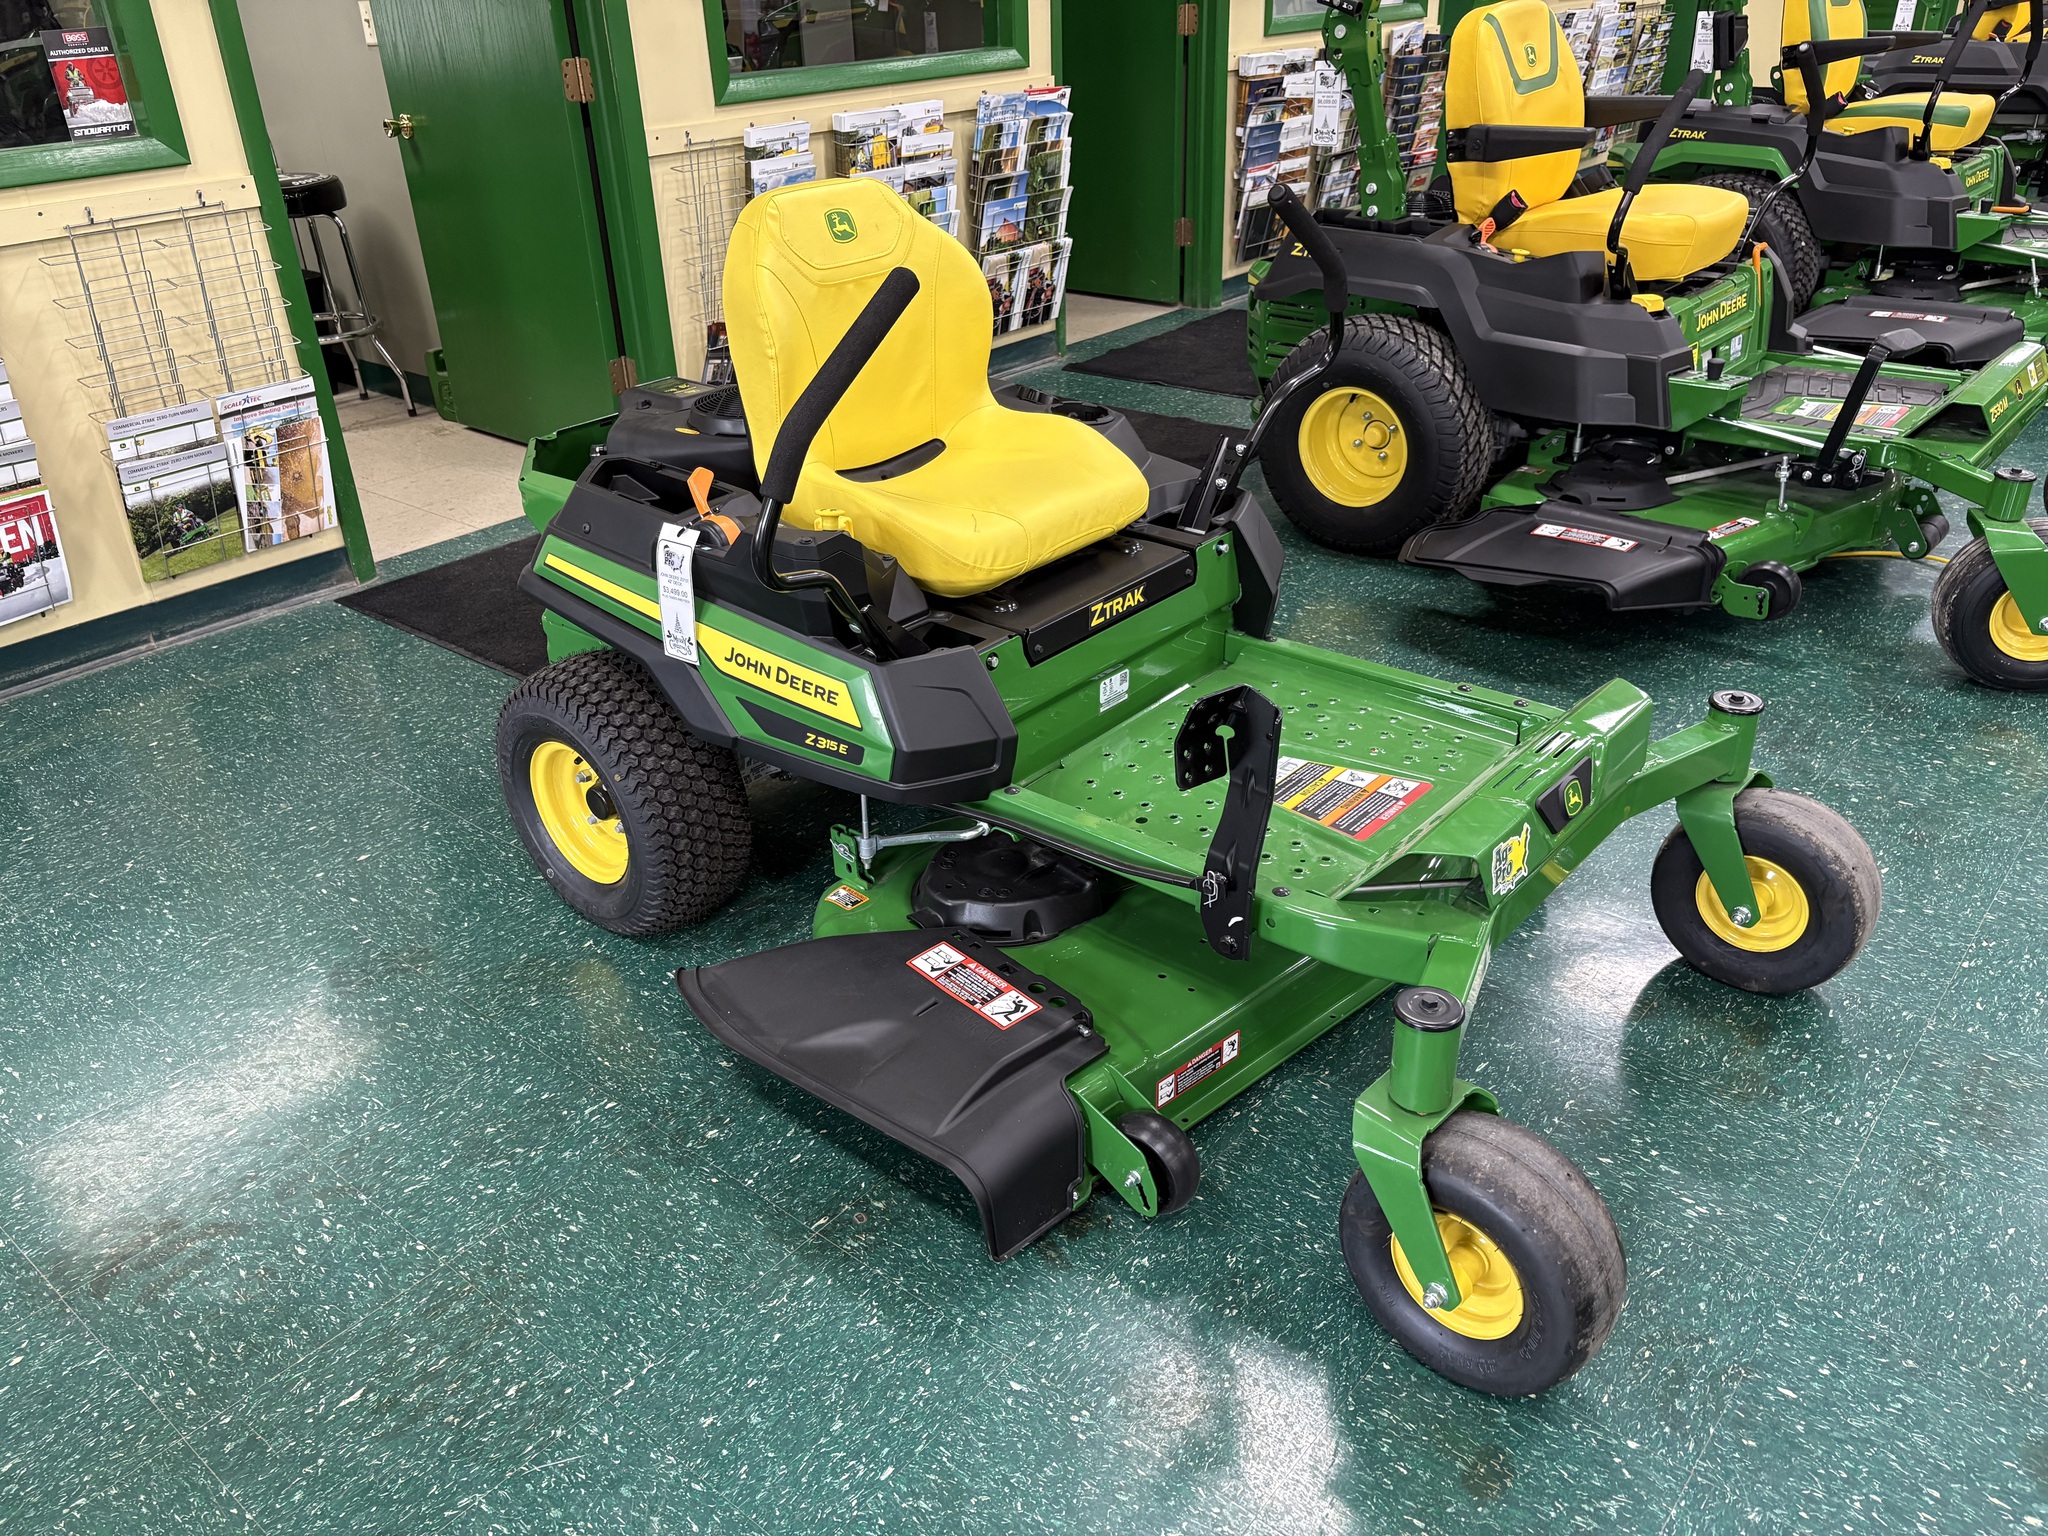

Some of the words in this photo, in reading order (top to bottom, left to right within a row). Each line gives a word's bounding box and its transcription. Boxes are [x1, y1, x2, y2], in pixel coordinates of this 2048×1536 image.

[65, 33, 87, 42] BOSS
[50, 48, 86, 56] AUTHORIZED
[87, 46, 109, 54] DEALER
[1911, 54, 1945, 64] ZTRAK
[74, 123, 130, 136] SNOWRATOR
[1669, 127, 1707, 140] ZTRAK
[1696, 307, 1719, 332] JOHN
[1720, 292, 1747, 320] DEERE
[223, 401, 243, 410] SCALE
[250, 395, 262, 403] TEC
[258, 406, 281, 416] Seeding
[112, 420, 141, 432] COMMERCIAL
[156, 411, 180, 422] ZERO-TURN
[180, 407, 199, 416] MOWERS
[3, 449, 24, 459] MOWERS
[127, 464, 156, 476] COMMERCIAL
[170, 455, 194, 466] ZERO-TURN
[193, 449, 213, 459] MOWERS
[1090, 585, 1145, 628] ZTRAK
[724, 646, 772, 680] JOHN
[775, 666, 839, 707] DEERE
[1494, 860, 1513, 889] Pro
[975, 966, 1008, 989] DANGER
[1191, 1047, 1213, 1065] DANGER
